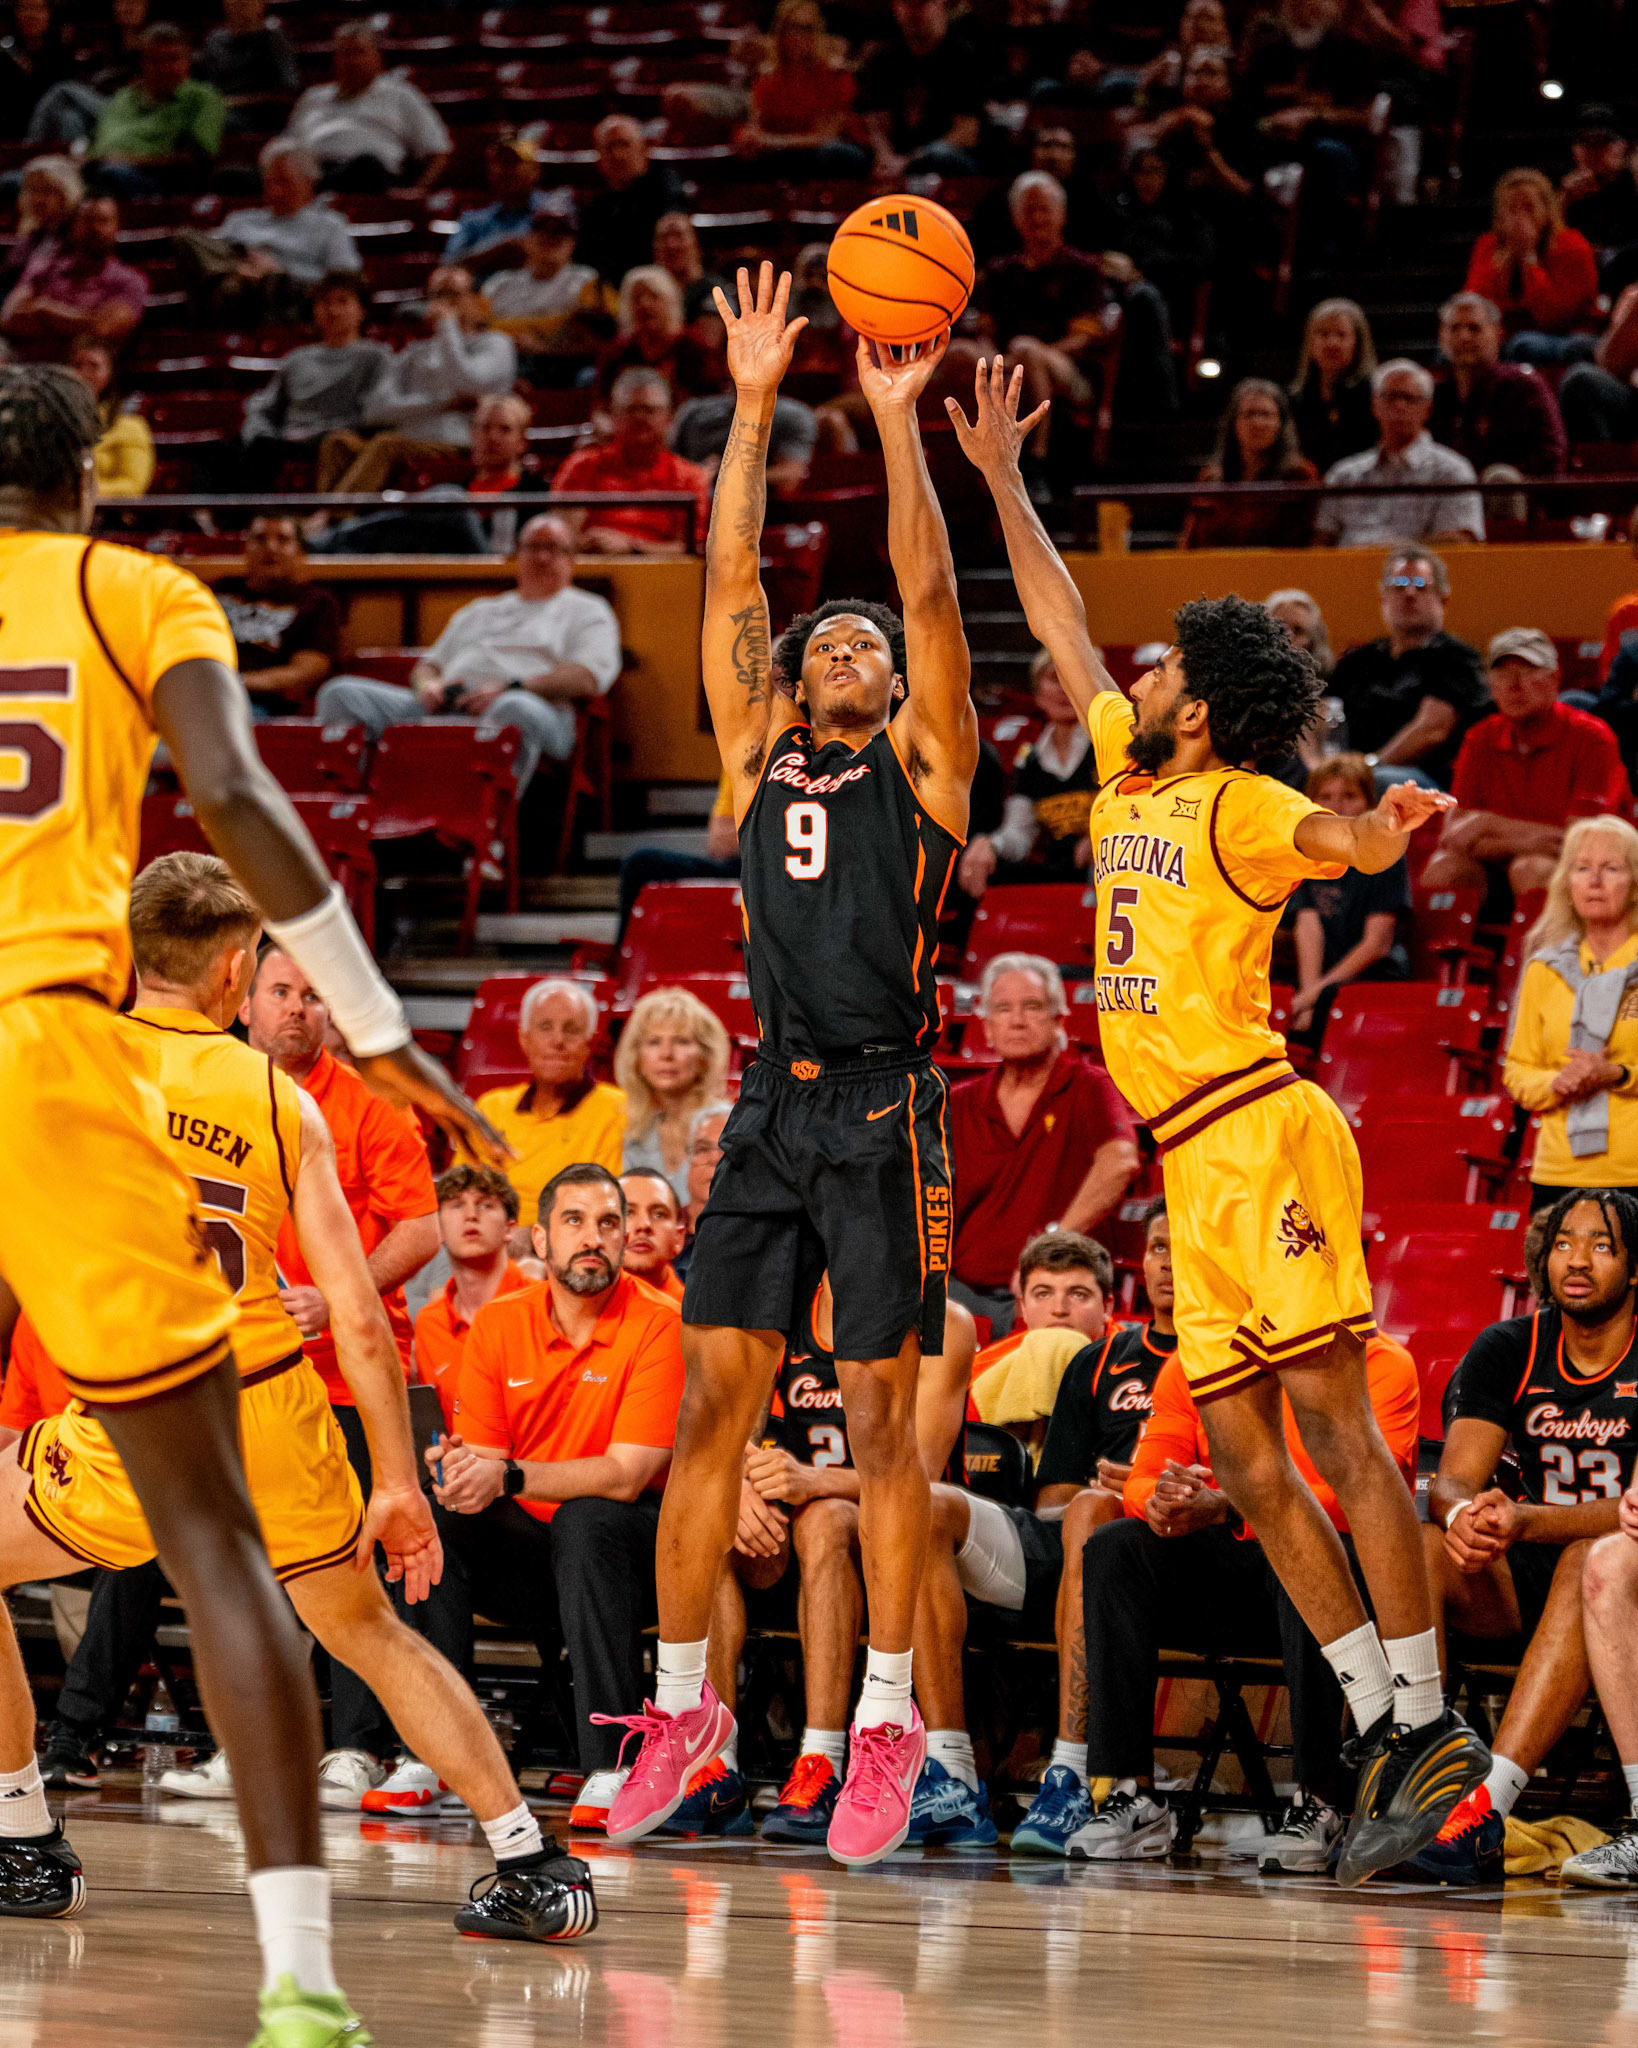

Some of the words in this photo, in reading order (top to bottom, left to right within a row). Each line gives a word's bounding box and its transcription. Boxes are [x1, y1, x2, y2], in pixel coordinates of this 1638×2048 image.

[784, 801, 828, 880] 9
[1106, 886, 1139, 967] 5
[791, 1060, 821, 1080] OSU
[926, 1186, 949, 1272] POKES
[1526, 1402, 1631, 1446] Cowboys
[1540, 1444, 1622, 1506] 23
